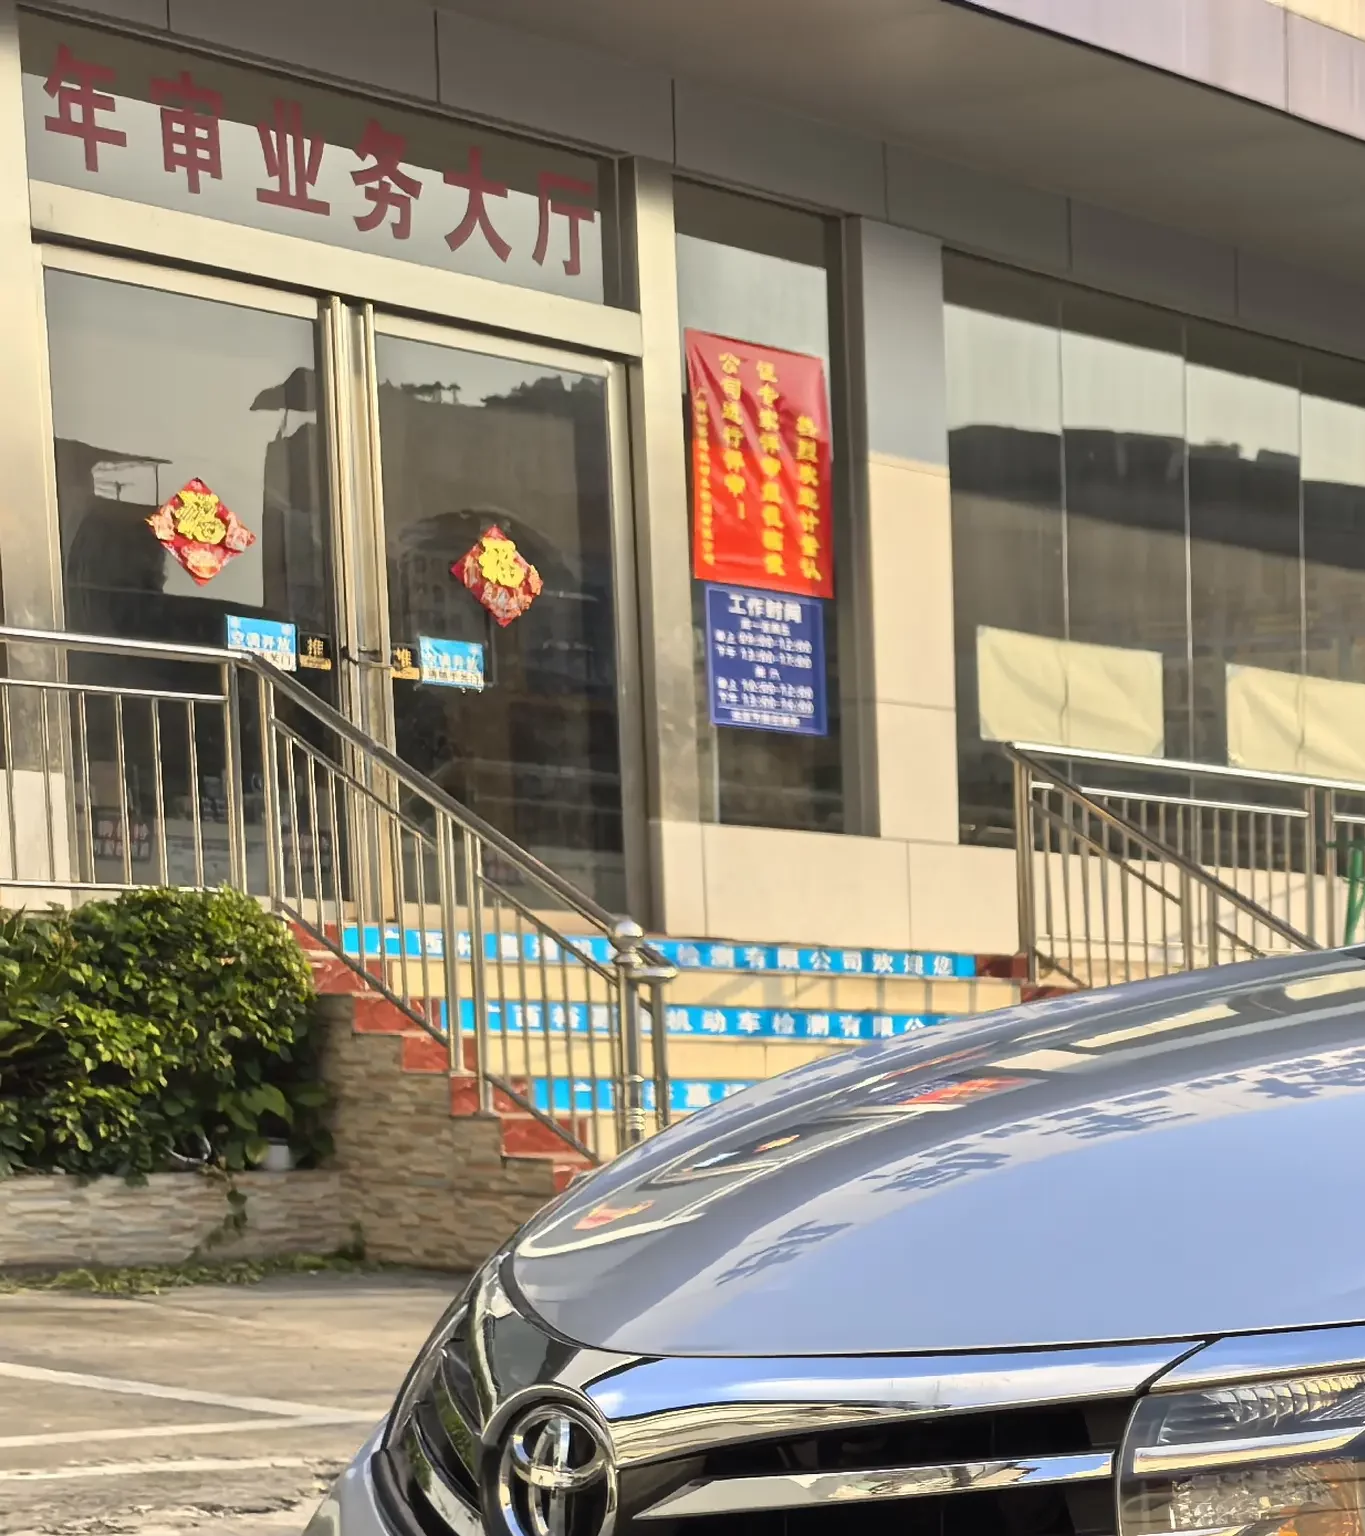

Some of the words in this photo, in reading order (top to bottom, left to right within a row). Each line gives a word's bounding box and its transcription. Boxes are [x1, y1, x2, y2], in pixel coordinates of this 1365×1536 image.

[43, 43, 597, 276] 年审业务大厅
